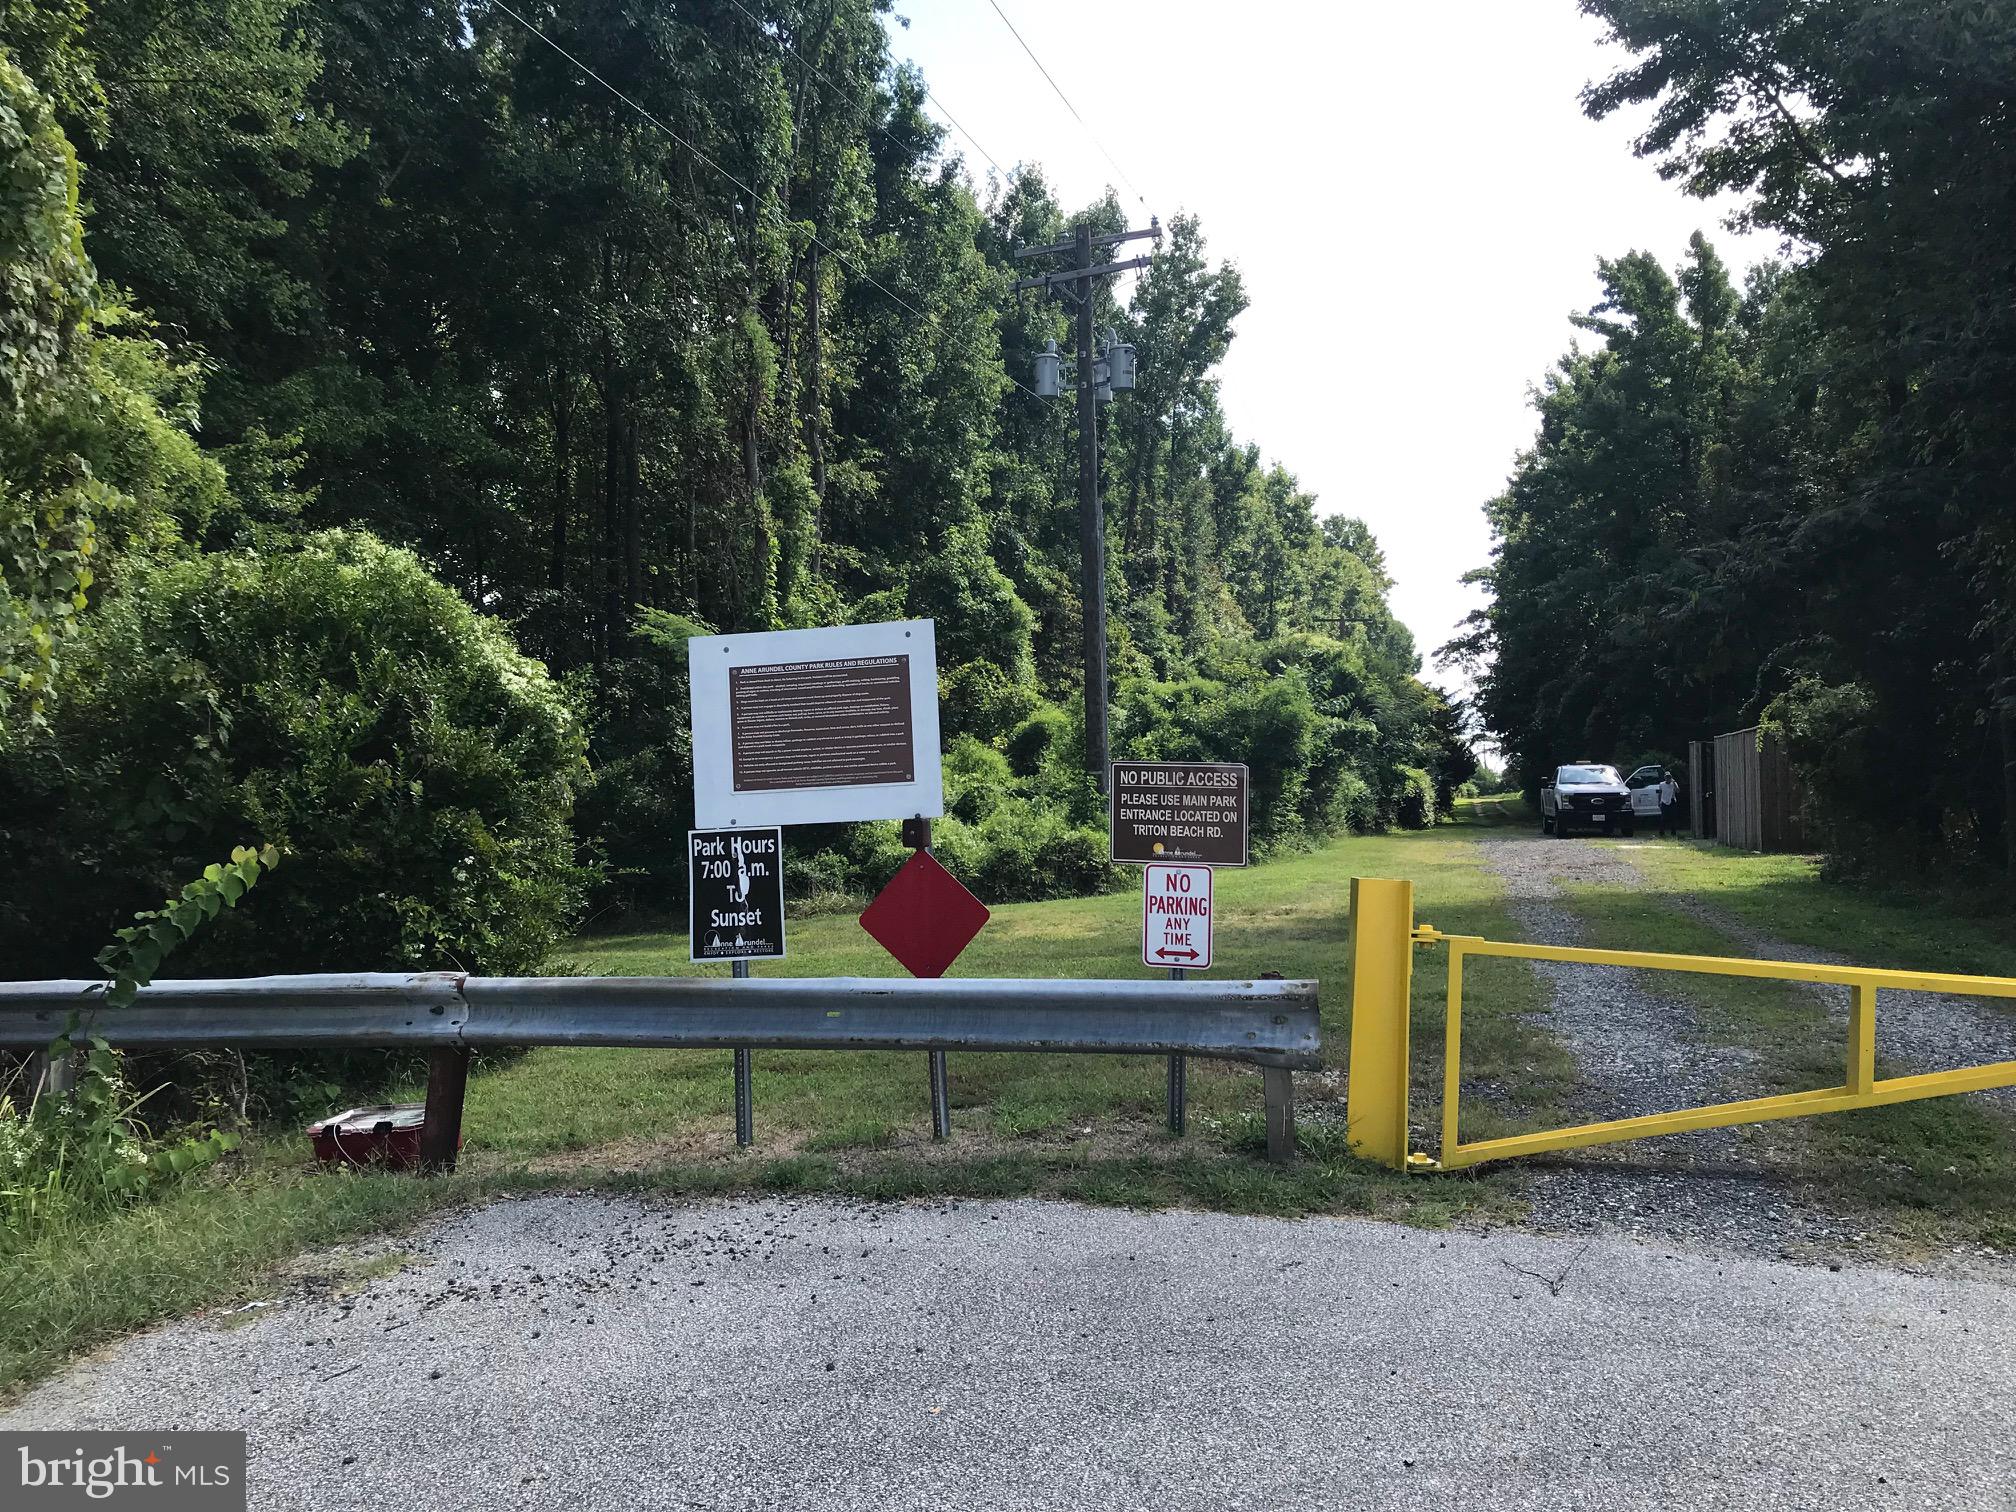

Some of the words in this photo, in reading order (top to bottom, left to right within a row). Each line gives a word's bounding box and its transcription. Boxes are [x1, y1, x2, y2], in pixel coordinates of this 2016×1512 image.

[741, 667, 758, 675] ANNE
[785, 664, 809, 672] COUNTY
[809, 662, 825, 670] PARK
[825, 661, 843, 669] RULES
[857, 657, 898, 666] REGULATIONS
[1120, 771, 1137, 785] NO
[1140, 771, 1184, 786] PUBLIC
[1187, 772, 1238, 787] ACCESS
[1121, 793, 1158, 805] PLEASE
[1160, 794, 1180, 806] USE
[1183, 795, 1207, 807] MAIN
[1210, 796, 1237, 807] PARK
[1120, 809, 1172, 821] ENTRANCE
[1174, 810, 1220, 822] LOCATED
[1222, 811, 1238, 823] ON
[1133, 824, 1168, 836] TRITON
[1170, 826, 1204, 837] BEACH
[1206, 827, 1224, 838] RD.
[693, 836, 725, 857] Park
[731, 836, 775, 856] Hours
[701, 860, 731, 879] 7:00
[738, 862, 769, 877] a.m.
[1166, 873, 1191, 893] NO
[726, 885, 746, 903] To
[1149, 895, 1207, 916] PARKING
[711, 908, 762, 928] Sunset
[1165, 917, 1191, 930] ANY
[1163, 932, 1192, 947] TIME
